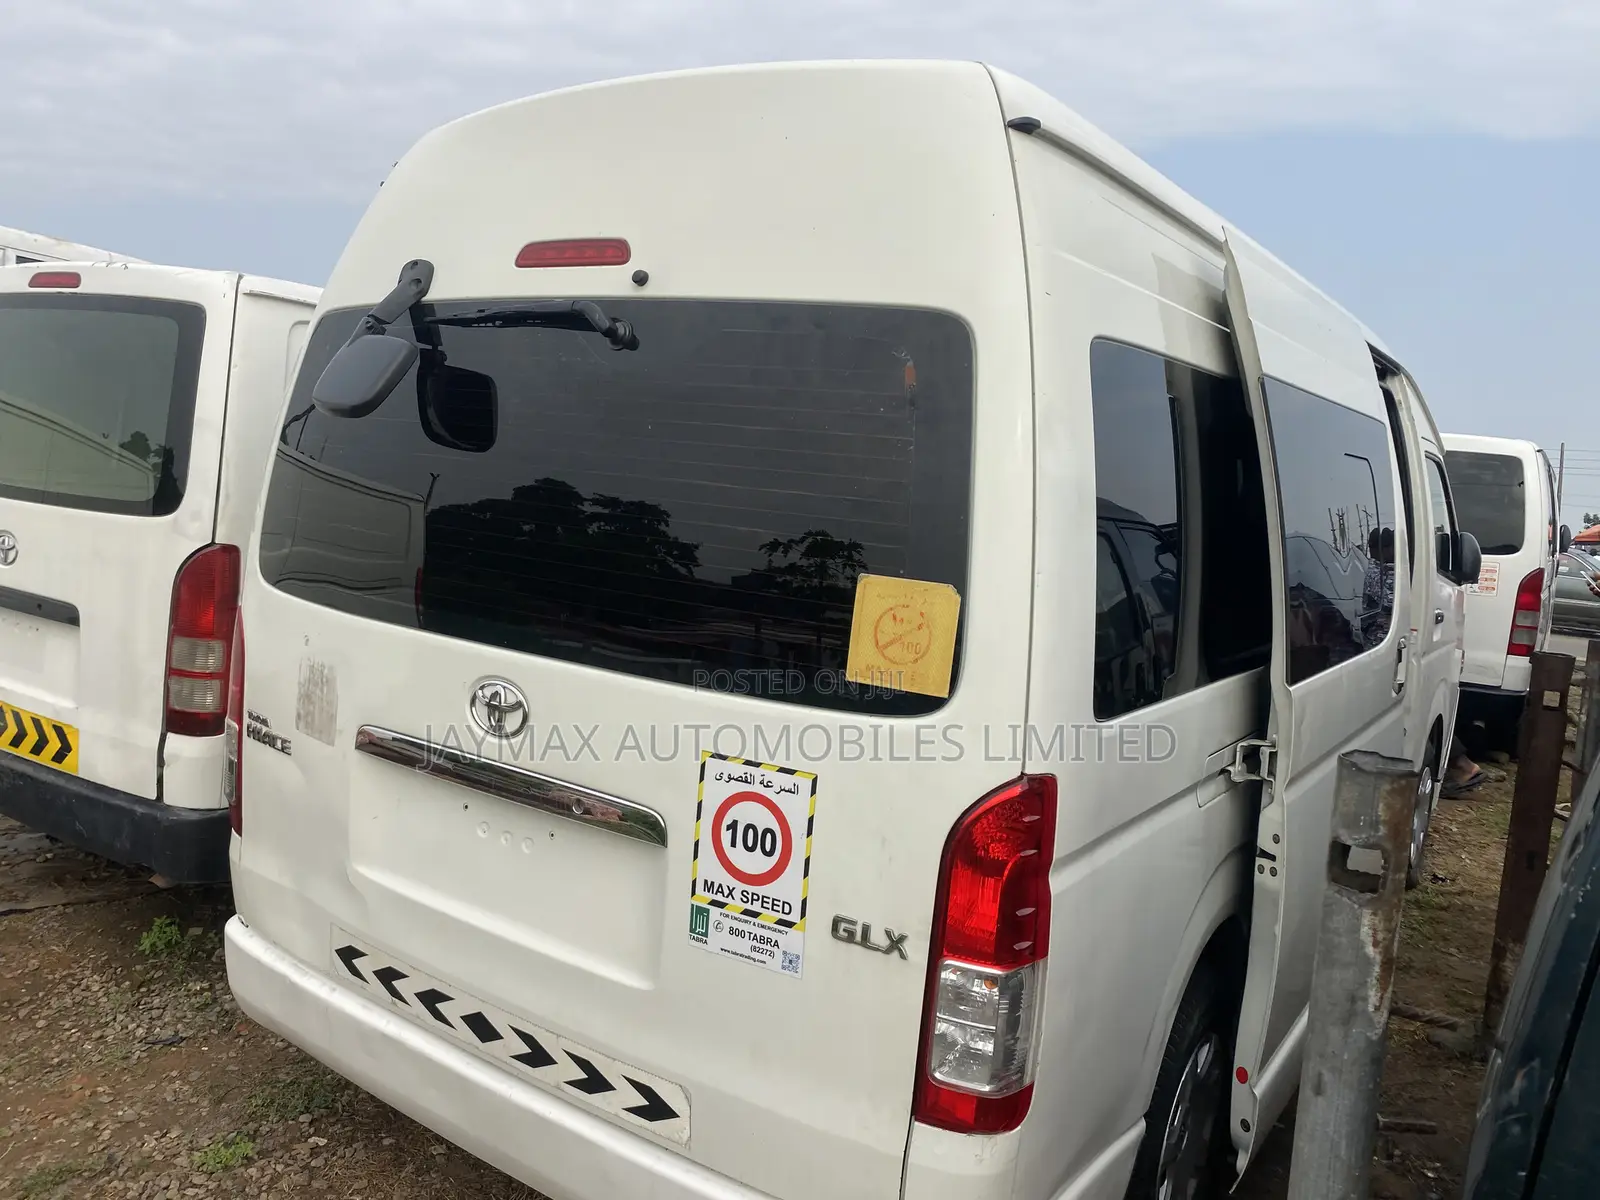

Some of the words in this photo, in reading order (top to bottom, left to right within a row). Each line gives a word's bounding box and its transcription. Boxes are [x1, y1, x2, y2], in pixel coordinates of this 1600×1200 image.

[714, 771, 755, 786] القصوى
[759, 774, 799, 795] السرعة
[725, 819, 777, 857] 100
[703, 879, 736, 901] MAX
[739, 889, 792, 916] SPEED
[730, 915, 752, 926] ENQUIRY
[757, 923, 789, 936] EMERGENCY
[689, 933, 708, 945] TABRA
[831, 914, 908, 960] GLX
[750, 944, 775, 959] (82272)
